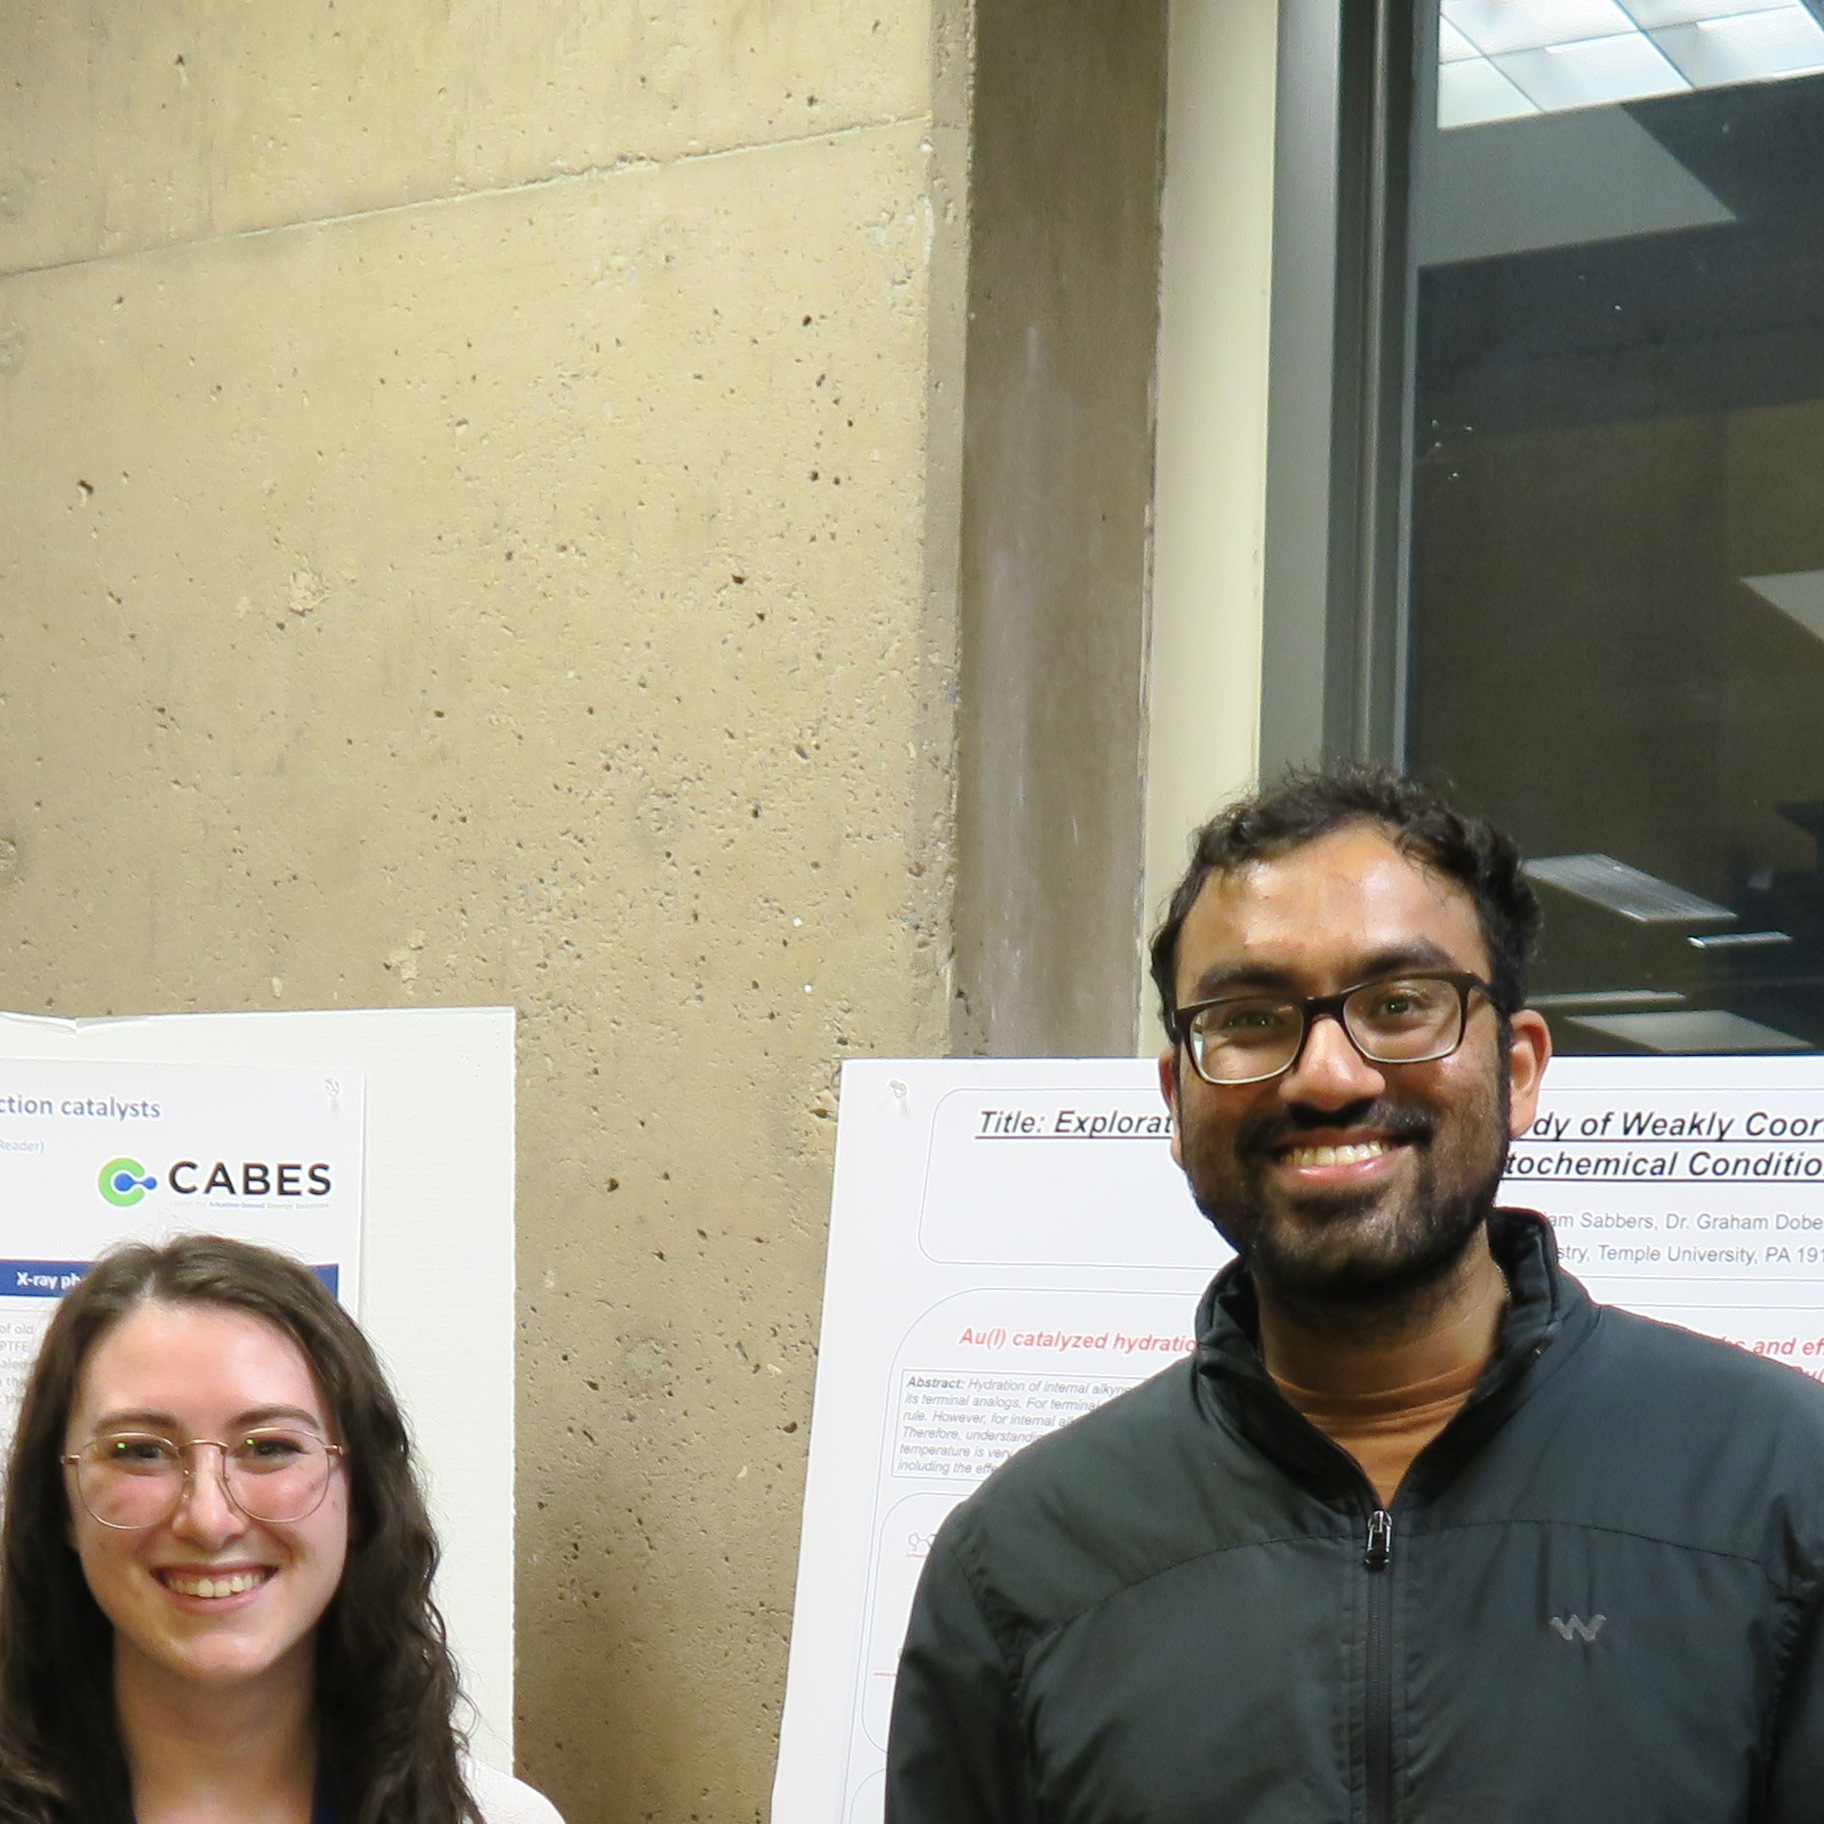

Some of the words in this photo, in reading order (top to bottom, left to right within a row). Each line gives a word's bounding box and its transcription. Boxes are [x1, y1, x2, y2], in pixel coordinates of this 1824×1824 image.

[61, 1097, 160, 1120] catalysts
[982, 1111, 1043, 1133] Title:
[1054, 1110, 1174, 1135] Explorat
[1580, 1111, 1614, 1135] of
[1623, 1112, 1733, 1139] Weakly
[1507, 1150, 1678, 1175] tochemical
[168, 1160, 332, 1197] CABES
[1580, 1212, 1657, 1229] Sabbers,
[1666, 1213, 1688, 1229] Dr.
[1696, 1213, 1768, 1229] Graham
[1598, 1244, 1660, 1264] Temple
[1667, 1245, 1757, 1266] University,
[1765, 1246, 1791, 1262] PA
[16, 1271, 58, 1289] X-ray
[1012, 1331, 1108, 1351] catalyzed
[1113, 1333, 1198, 1356] hydratio
[1752, 1338, 1796, 1356] and
[906, 1376, 964, 1388] Abstract:
[968, 1378, 1025, 1391] Hydration
[1028, 1380, 1042, 1391] of
